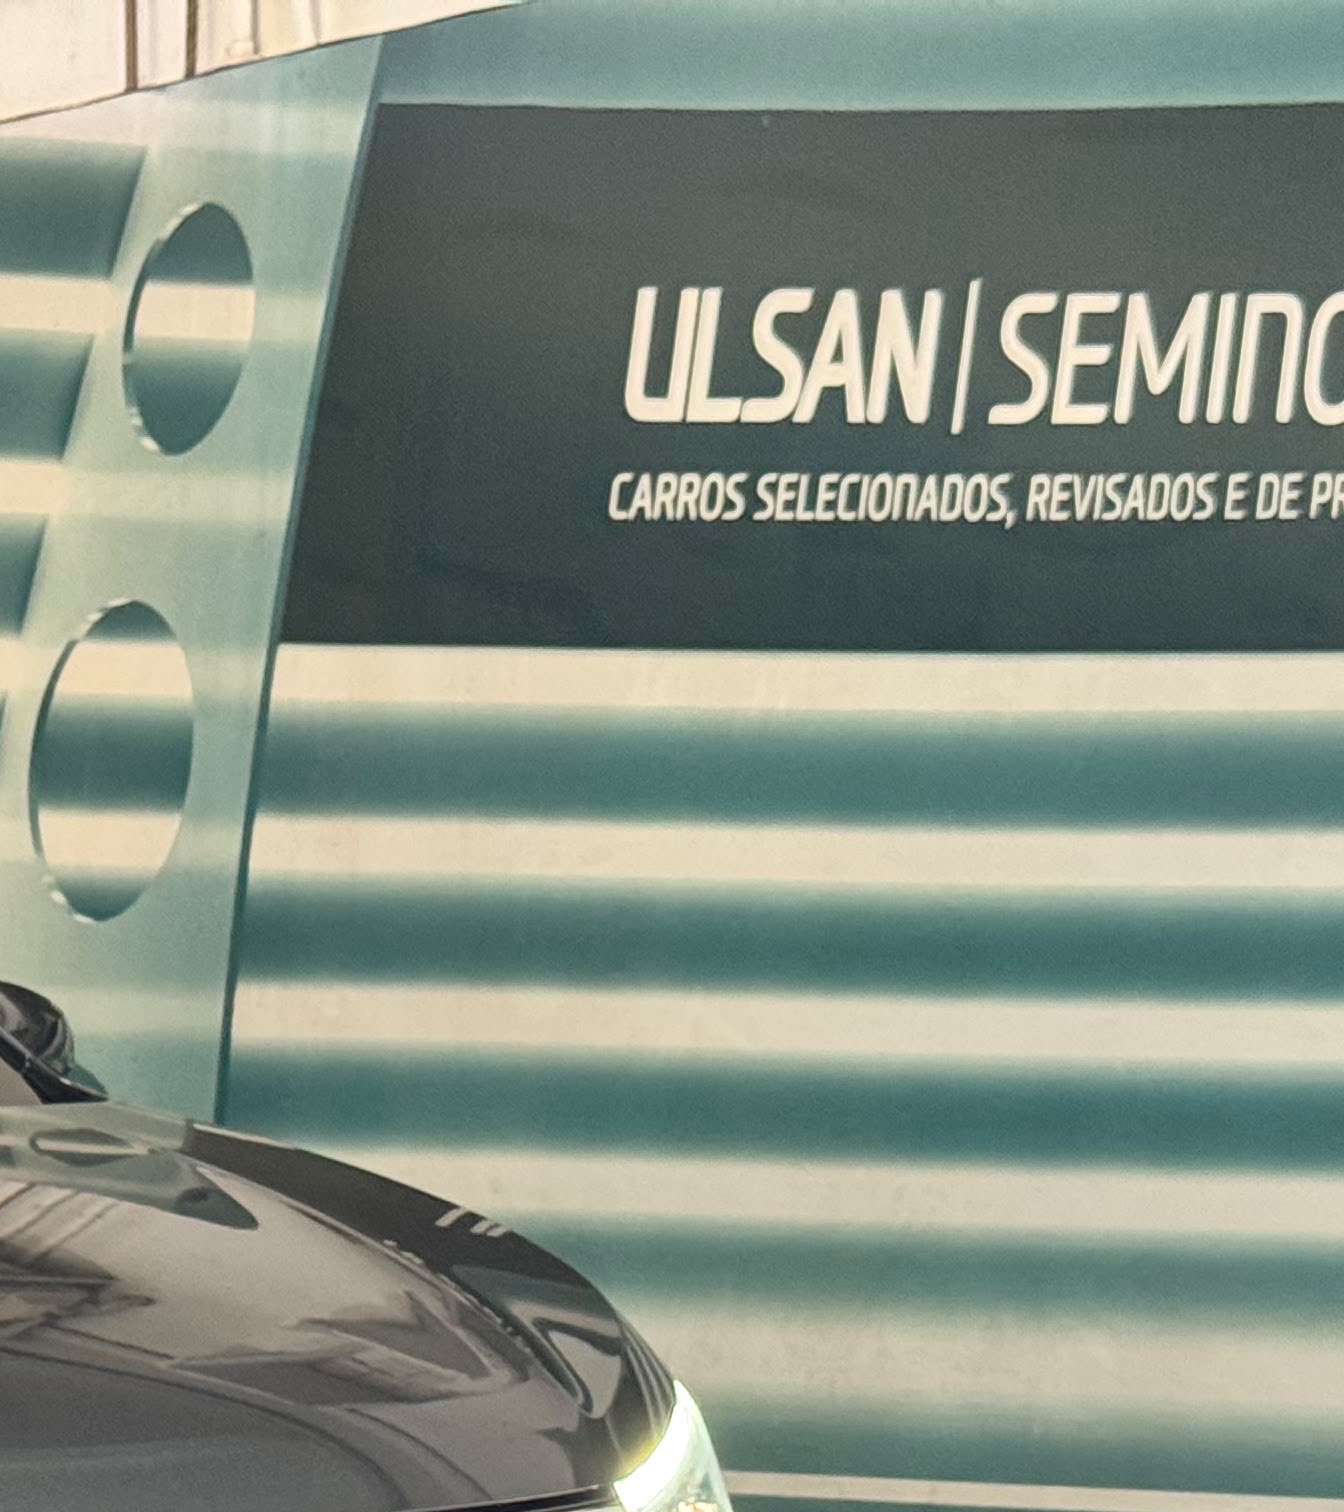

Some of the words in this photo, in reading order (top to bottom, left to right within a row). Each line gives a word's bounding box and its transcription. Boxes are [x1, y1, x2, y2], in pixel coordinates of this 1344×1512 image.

[624, 286, 944, 424] ULSAN
[608, 471, 748, 522] CARROS
[752, 472, 1016, 530] SELECIONADOS,
[1026, 472, 1217, 523] REVISADOS
[1224, 472, 1251, 521] E
[1255, 472, 1305, 521] DE
